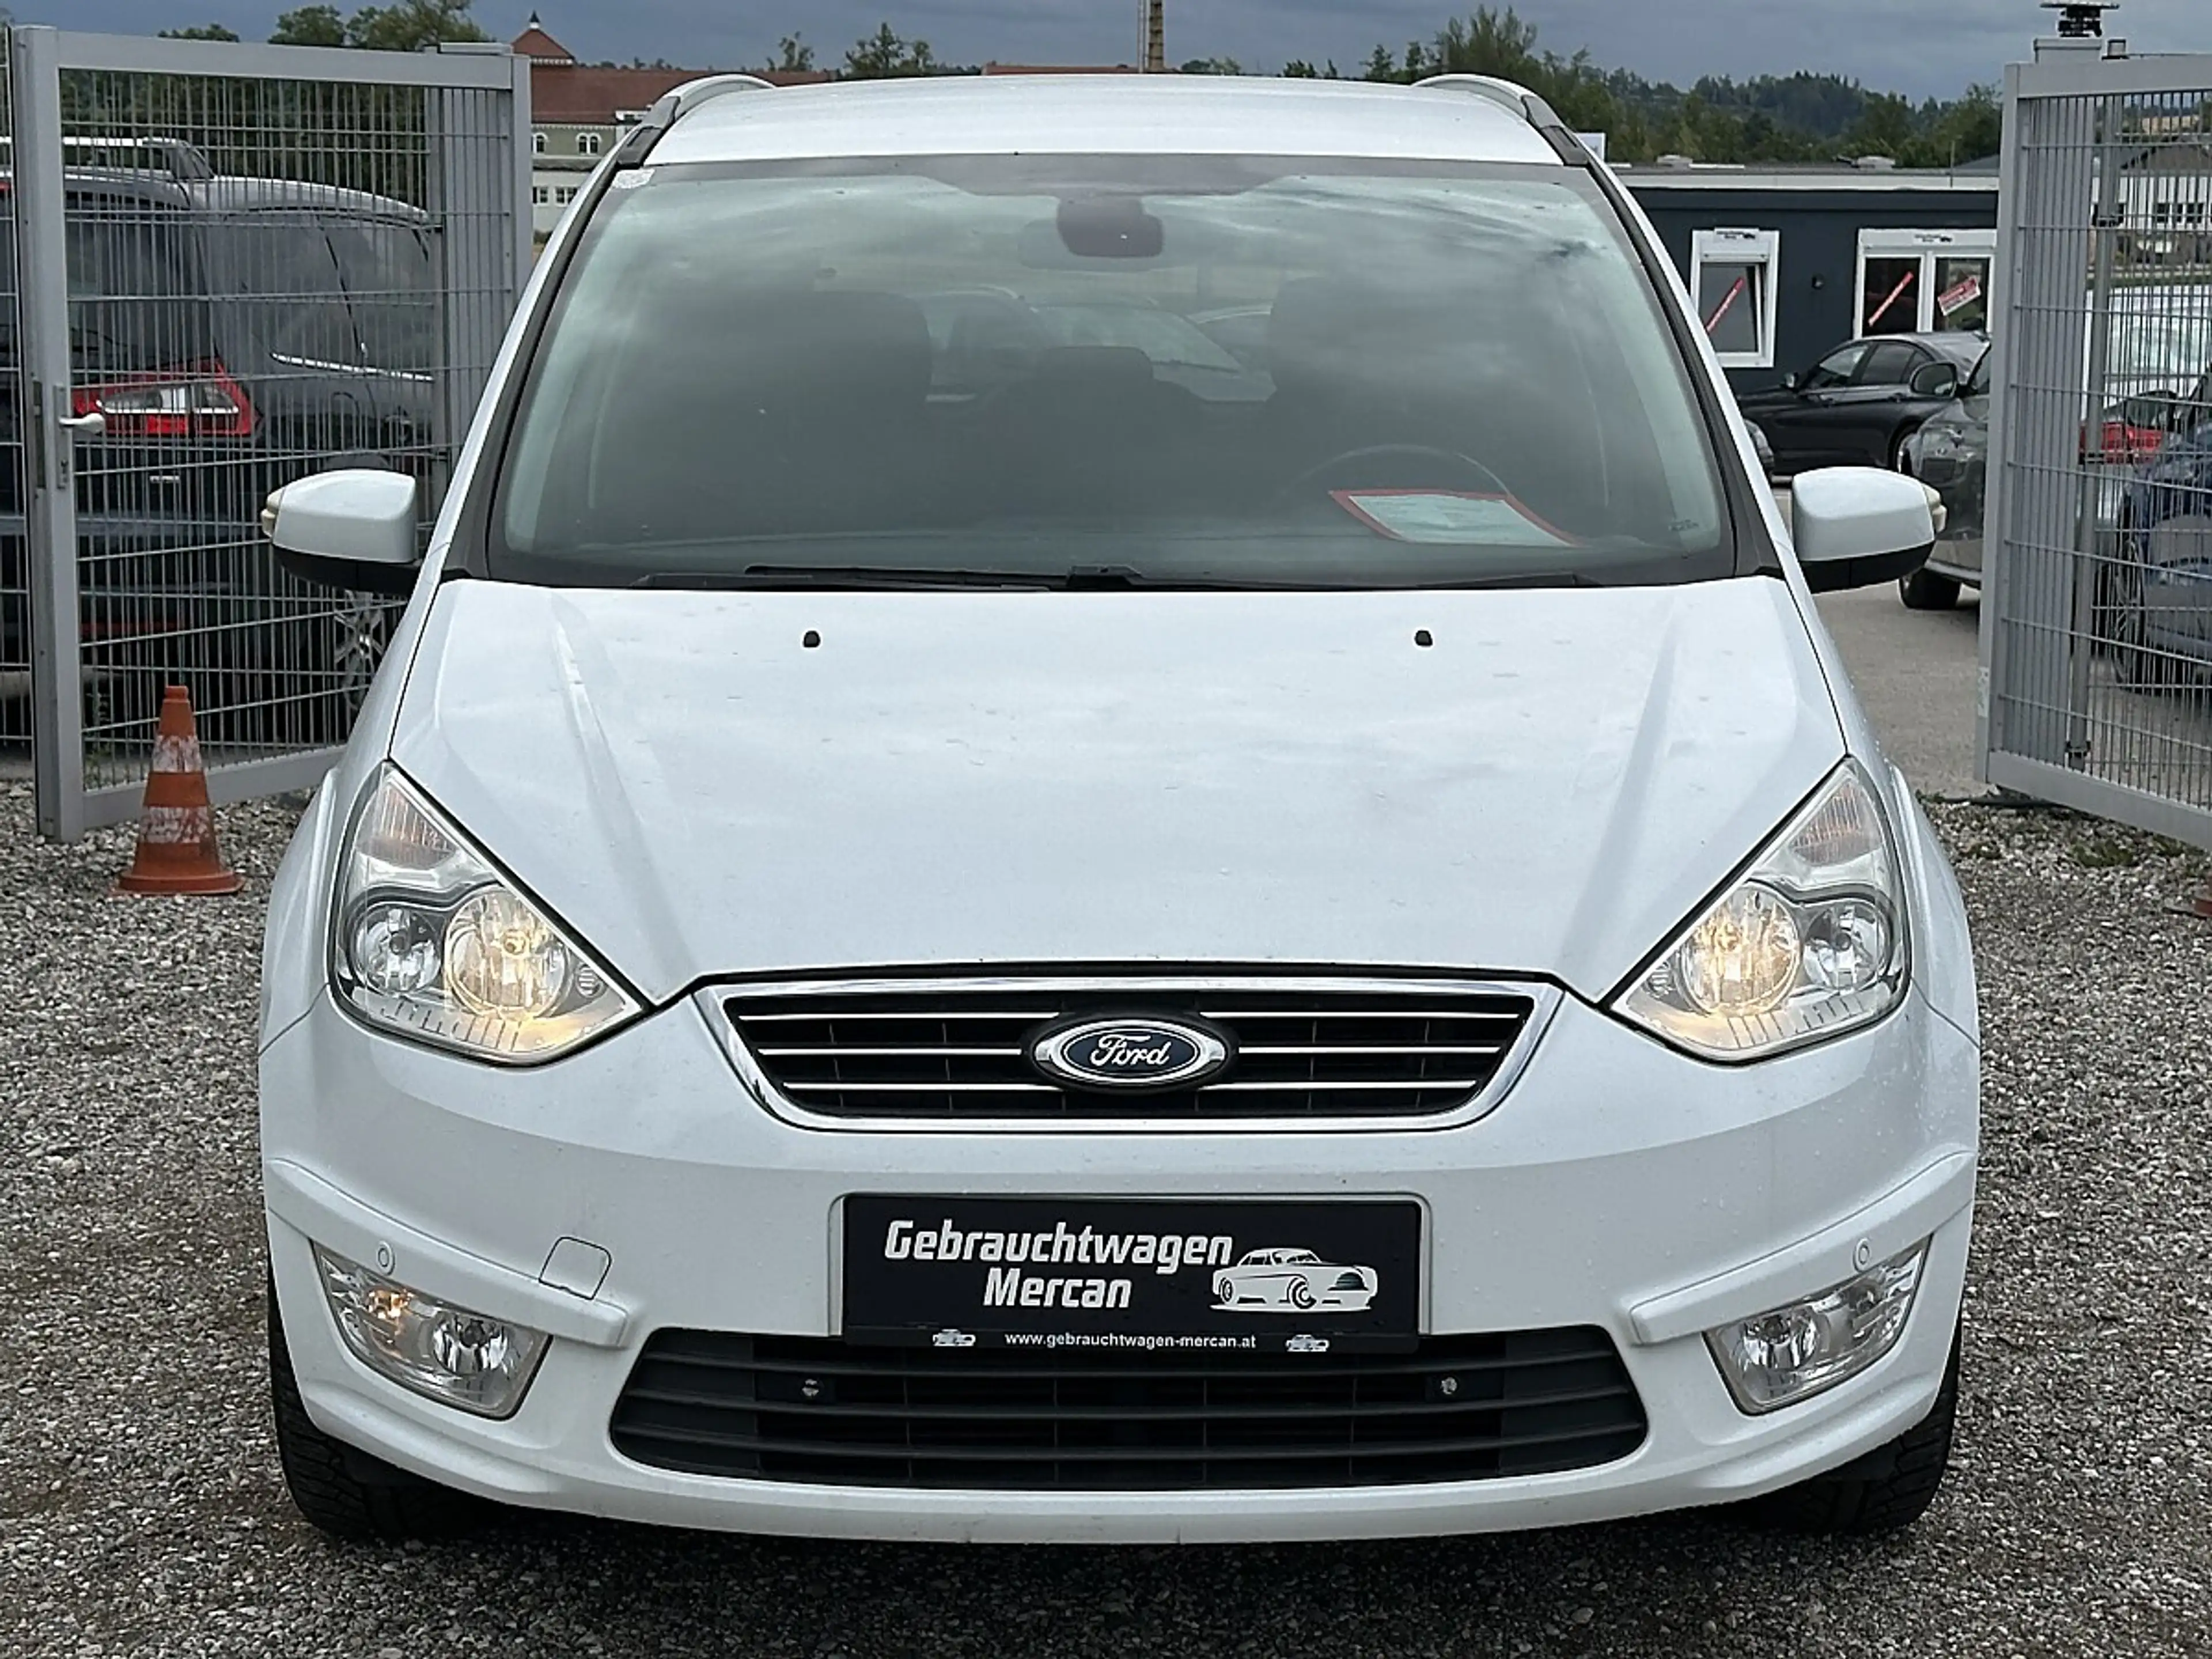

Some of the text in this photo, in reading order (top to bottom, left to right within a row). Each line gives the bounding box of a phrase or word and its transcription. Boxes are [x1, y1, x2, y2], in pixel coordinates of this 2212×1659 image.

[1090, 1035, 1172, 1066] Ford
[884, 1219, 1233, 1275] Gebrauchtwagen
[983, 1268, 1131, 1308] Mercan
[1005, 1332, 1256, 1350] www.gebrauchtwagen-mercan.at
